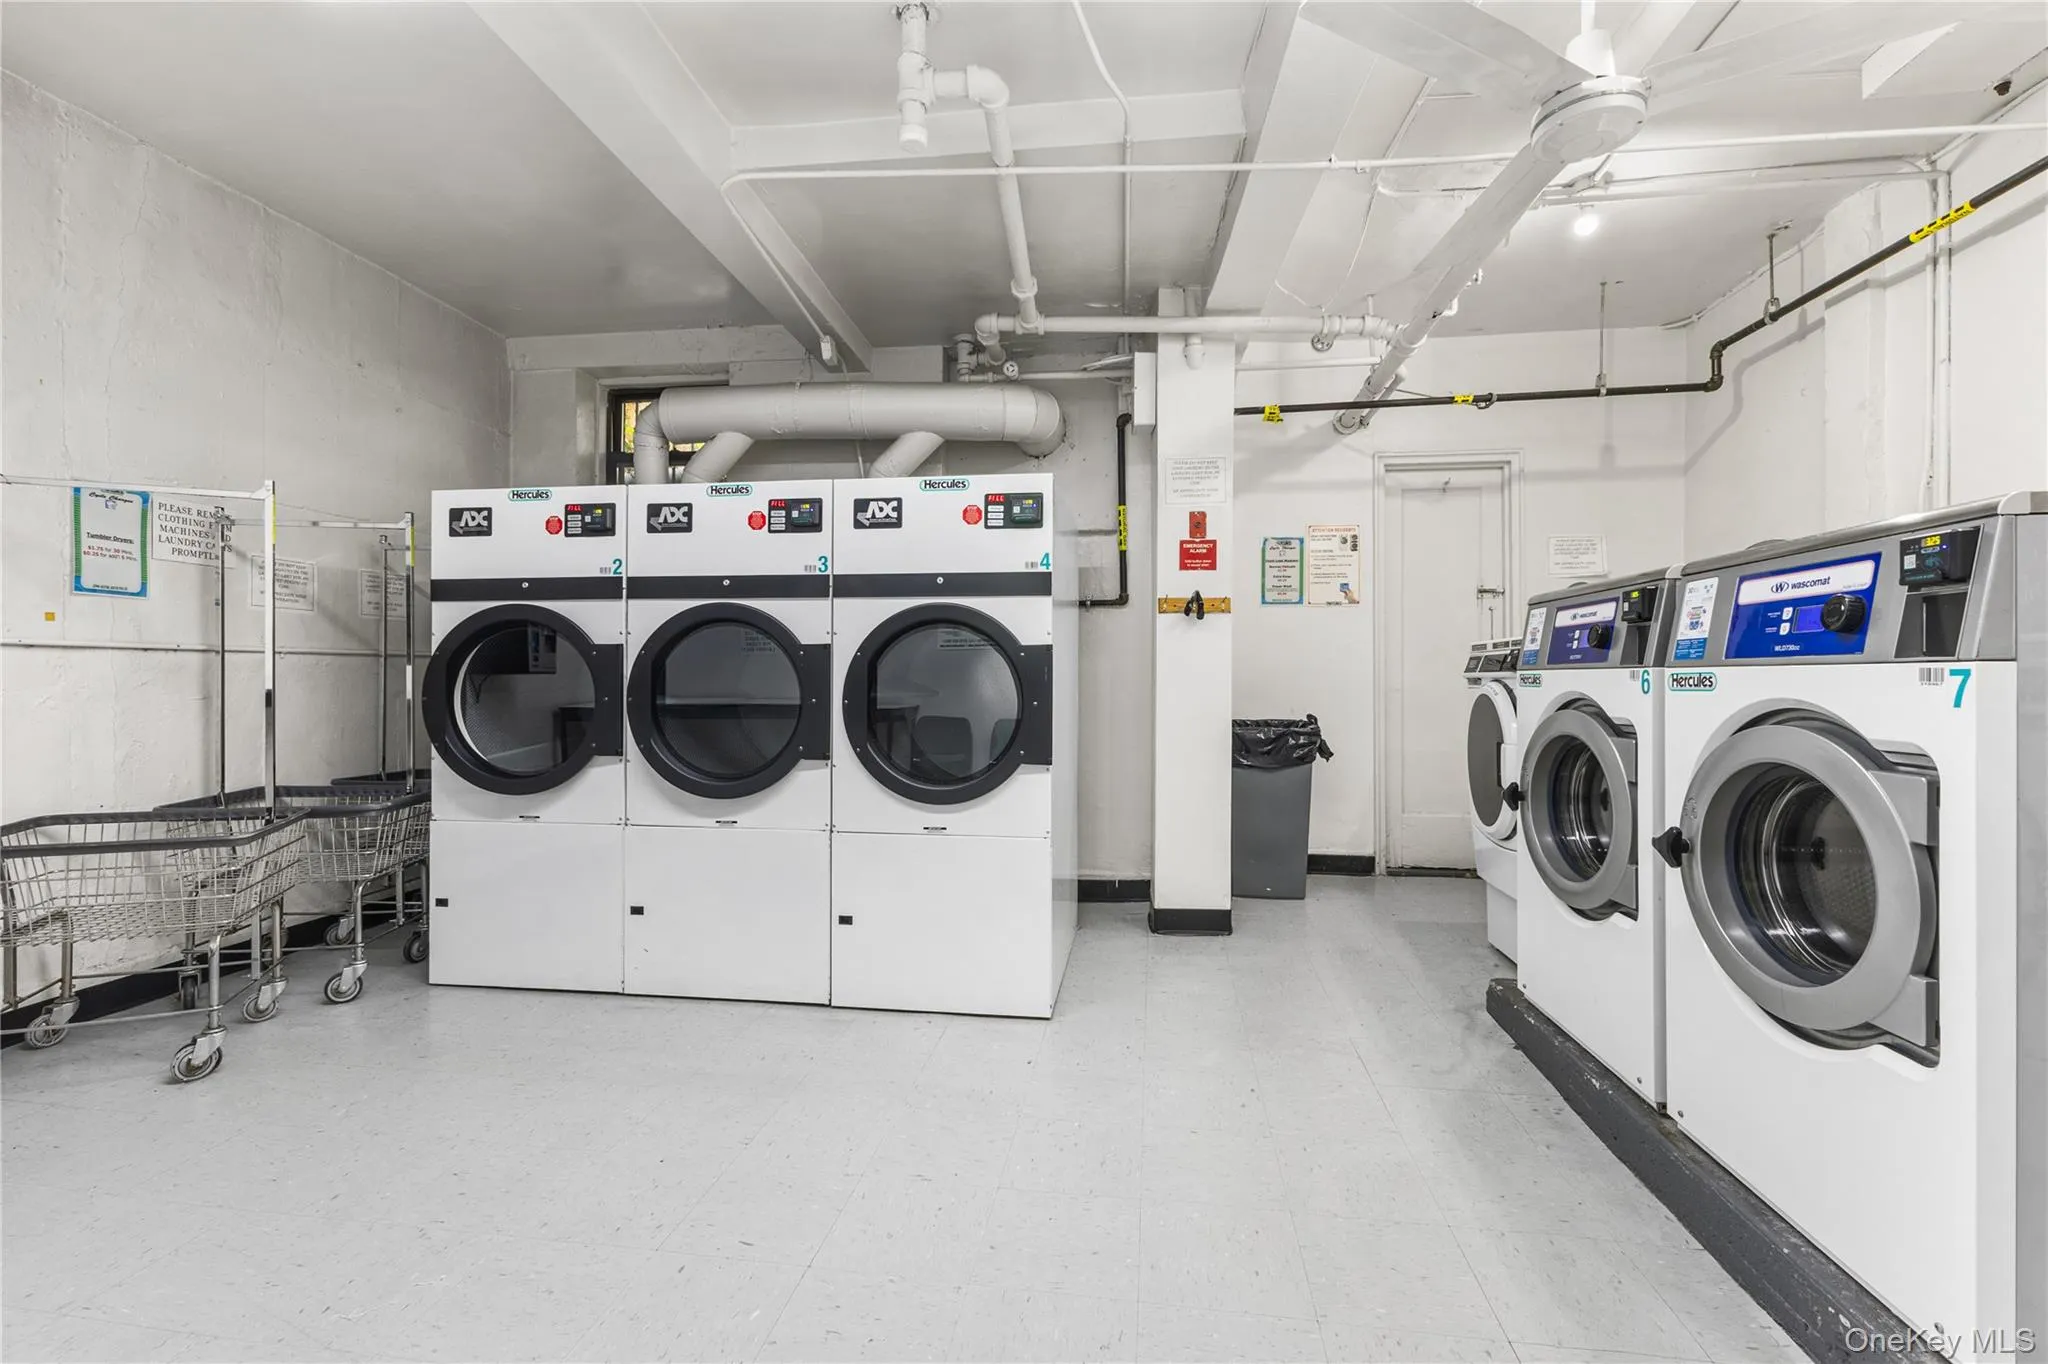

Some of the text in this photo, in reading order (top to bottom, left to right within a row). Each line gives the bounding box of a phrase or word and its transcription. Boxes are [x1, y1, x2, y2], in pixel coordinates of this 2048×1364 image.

[710, 484, 750, 494] Hercules
[924, 479, 966, 489] Hercules
[512, 490, 550, 498] Hercules
[158, 502, 193, 516] PLEASE
[658, 506, 688, 522] ADC
[866, 500, 898, 518] ADC
[158, 513, 205, 528] CLOTHING
[460, 510, 488, 526] ADC
[160, 524, 210, 538] MACHINES
[158, 534, 202, 548] LAUNDRY
[613, 558, 622, 575] 2
[818, 556, 828, 572] 3
[1040, 552, 1051, 570] 4
[1791, 576, 1831, 590] wascomat
[1520, 674, 1541, 684] Hercules
[1642, 670, 1650, 694] 6
[1671, 673, 1713, 688] Hercules
[1949, 668, 1971, 708] 7
